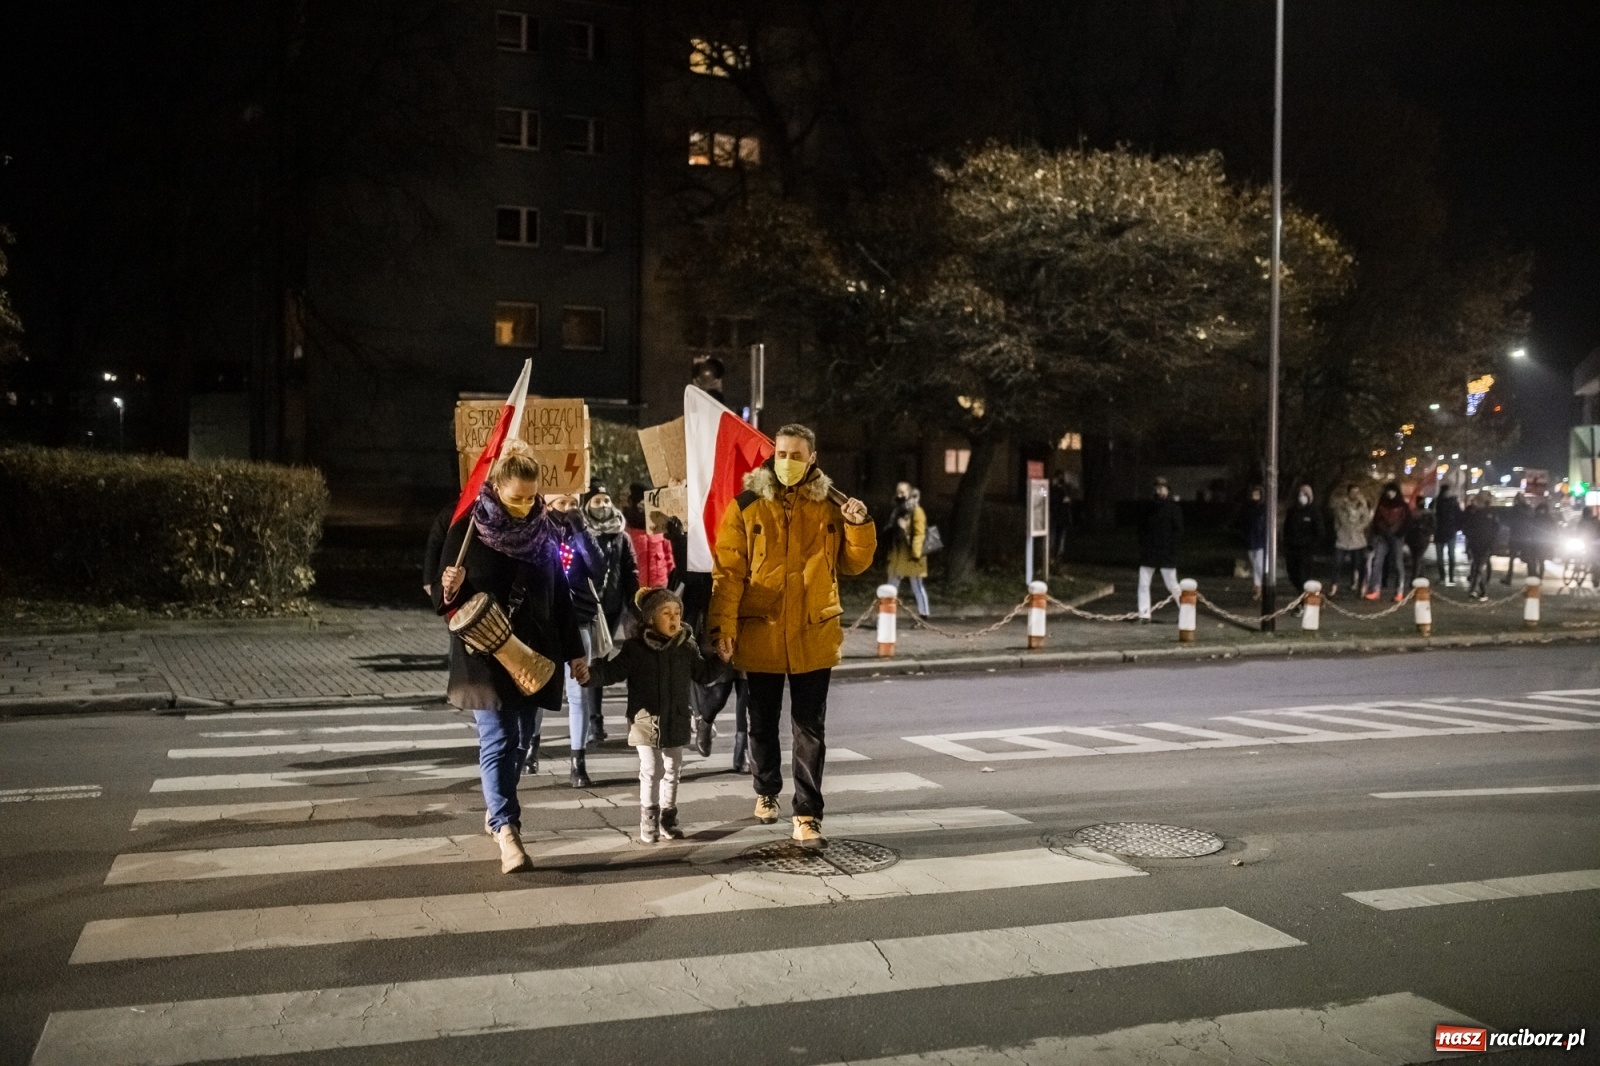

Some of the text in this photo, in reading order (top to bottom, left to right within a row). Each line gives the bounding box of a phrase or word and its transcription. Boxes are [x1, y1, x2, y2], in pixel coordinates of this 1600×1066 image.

[467, 407, 583, 428] STRA W OCZACH
[464, 425, 573, 447] KACZ LEPSZY
